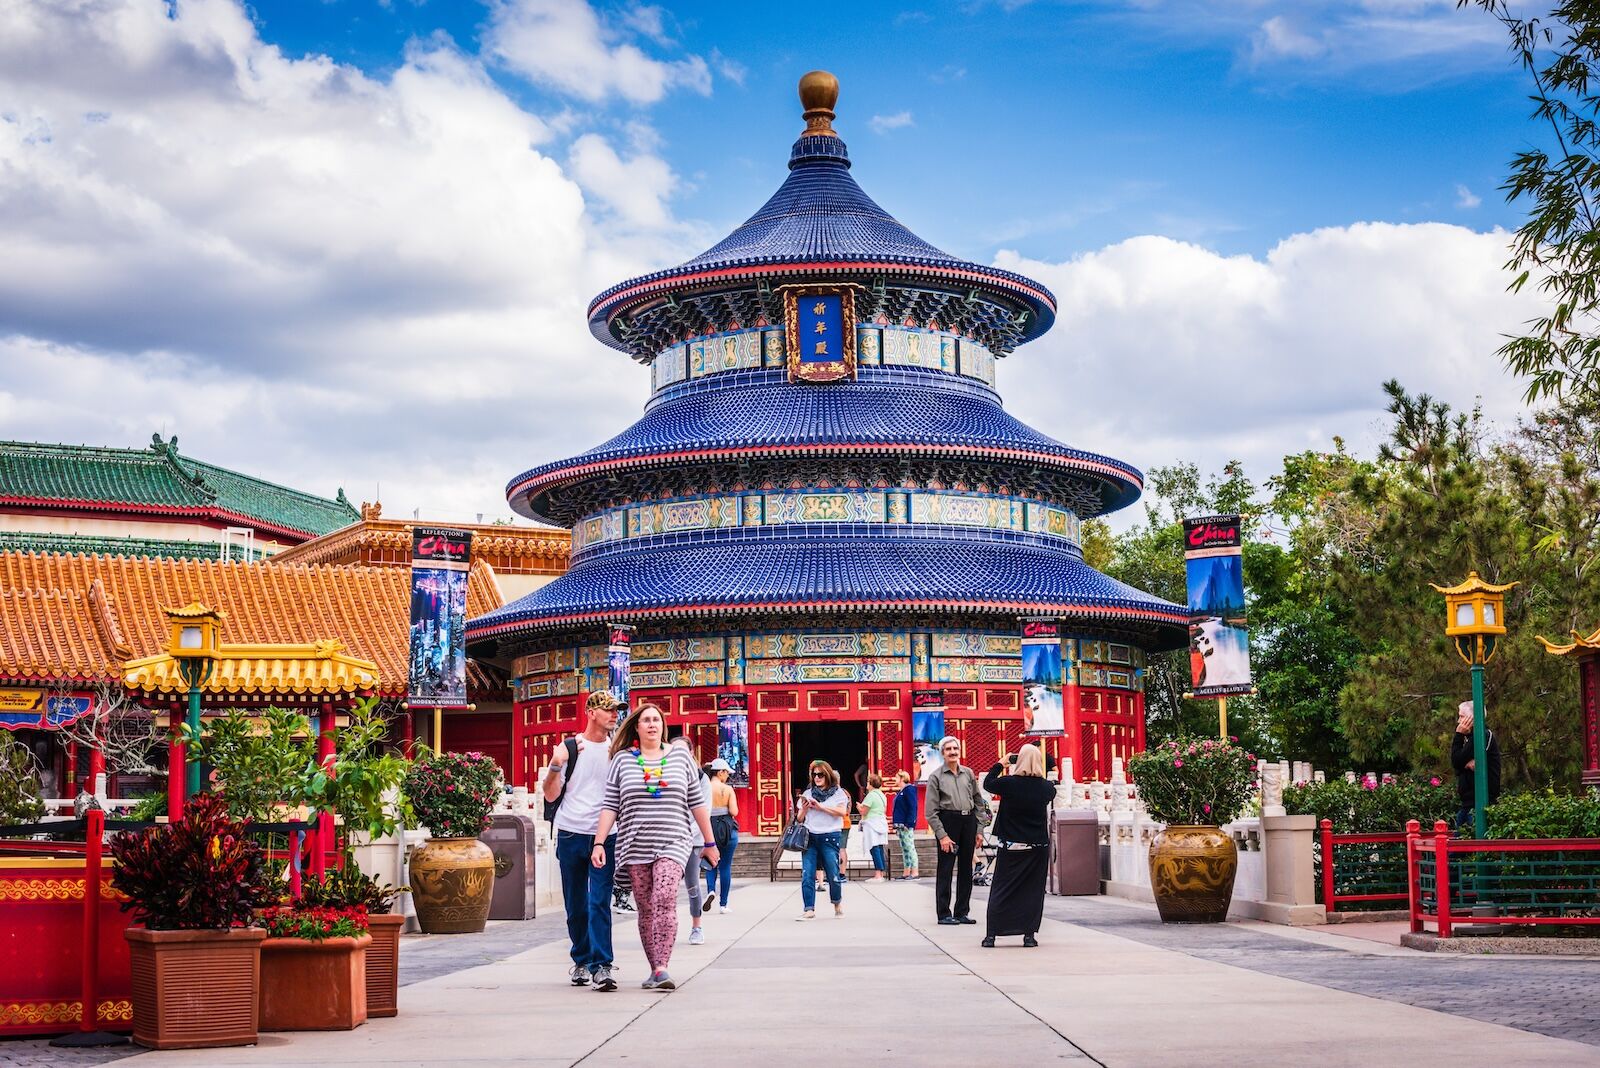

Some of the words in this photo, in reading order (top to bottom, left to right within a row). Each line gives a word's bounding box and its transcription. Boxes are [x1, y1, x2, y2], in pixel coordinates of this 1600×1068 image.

[1191, 516, 1232, 525] REFLECTIONS
[422, 529, 465, 537] REFLECTIONS
[1189, 524, 1235, 545] China
[417, 535, 466, 555] China
[1024, 622, 1057, 637] China
[915, 694, 941, 705] China
